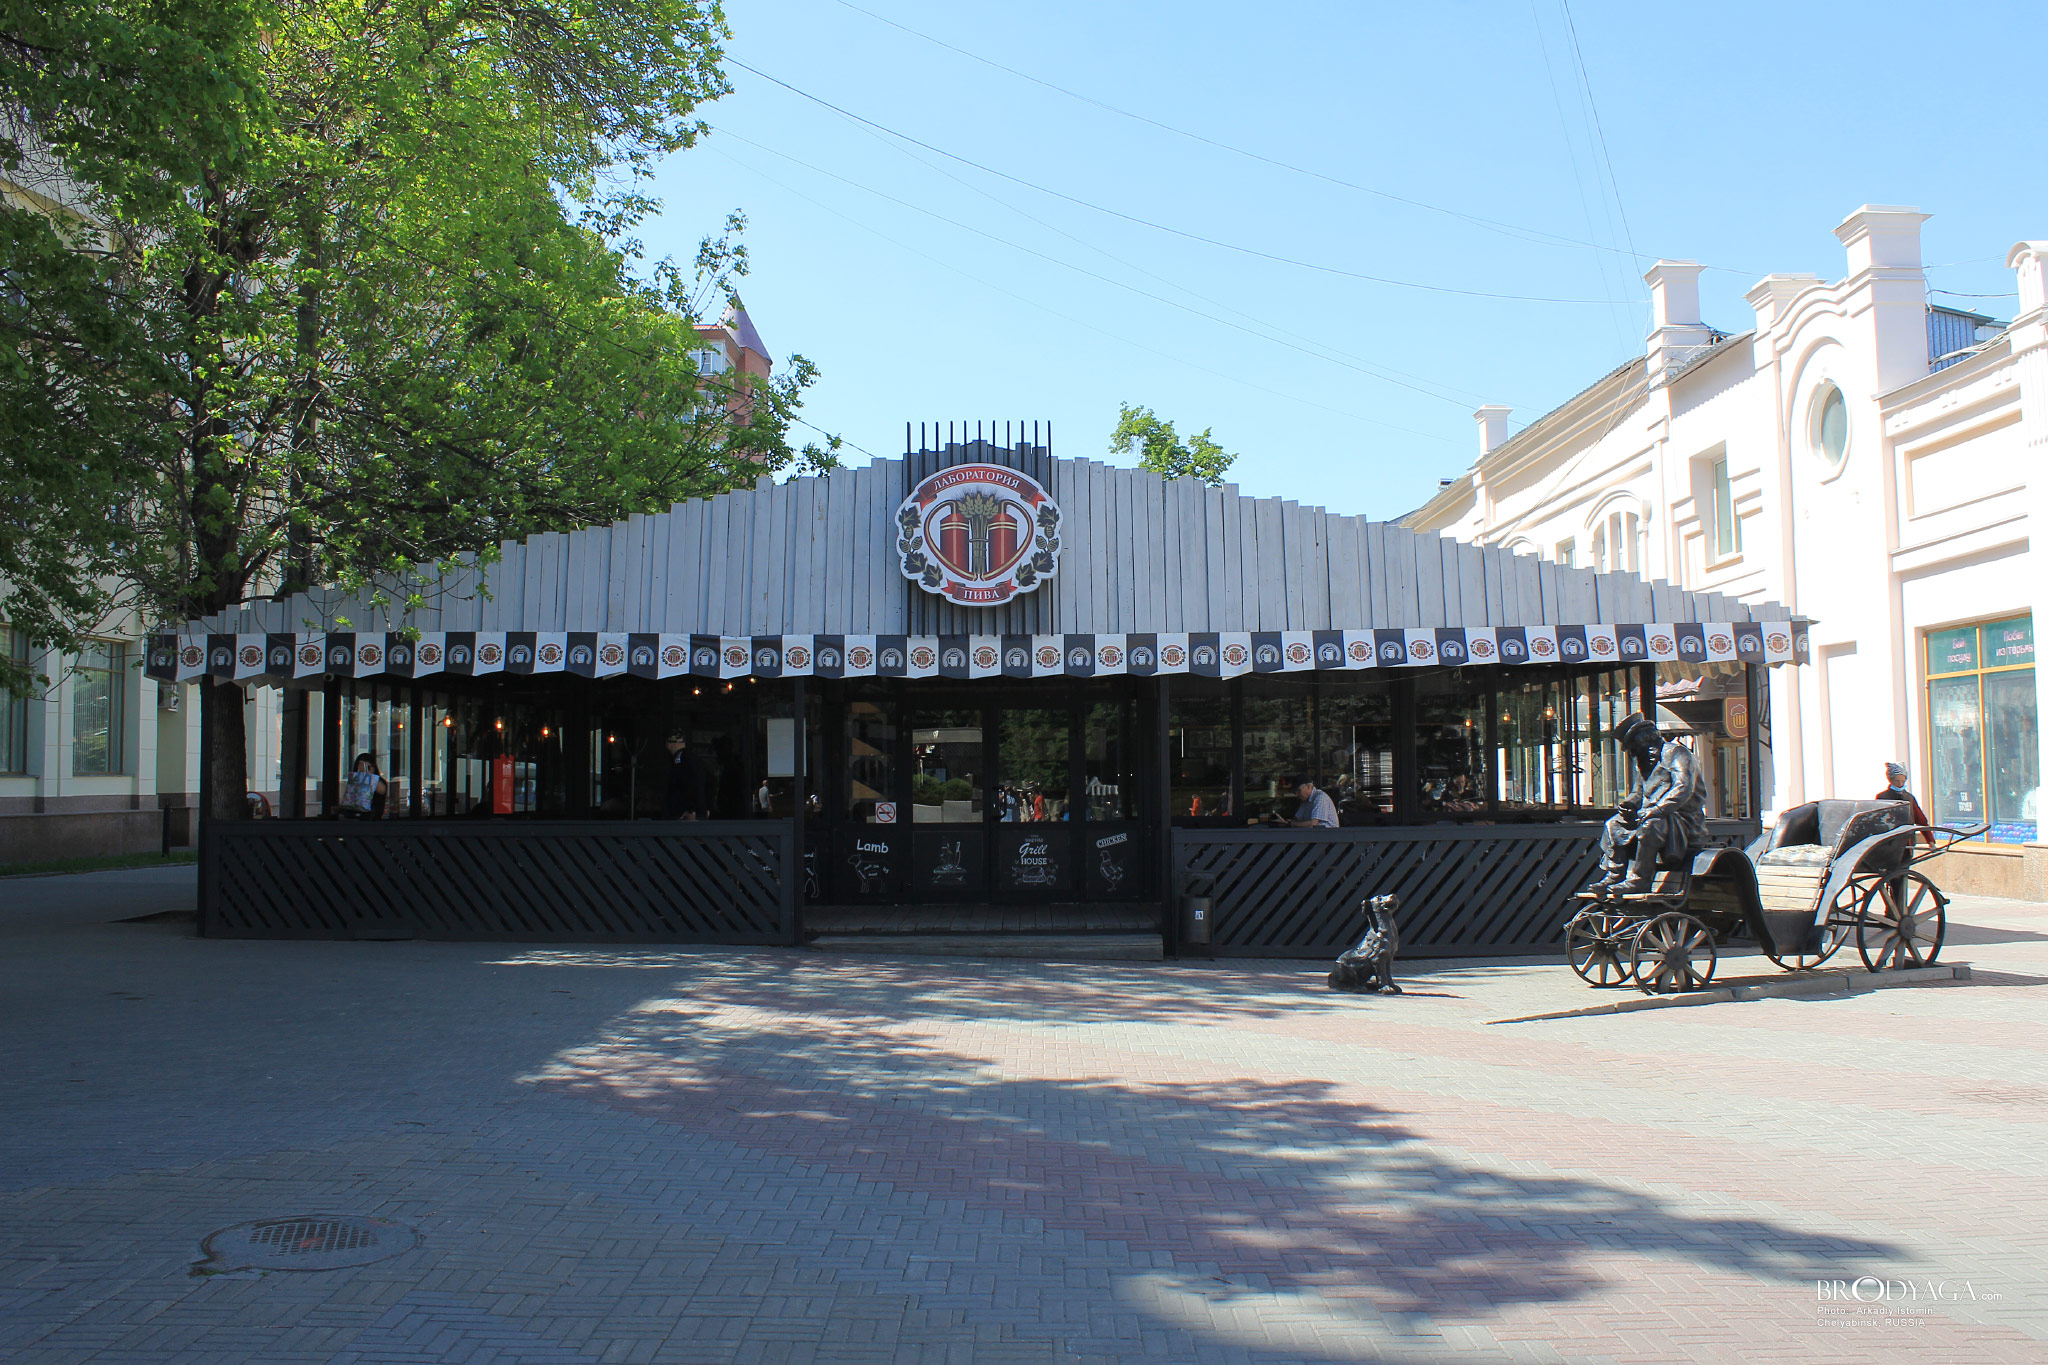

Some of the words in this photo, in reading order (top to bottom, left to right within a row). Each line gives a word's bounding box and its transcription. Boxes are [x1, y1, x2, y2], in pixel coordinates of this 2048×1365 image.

[934, 471, 1020, 491] ЛАБОРАТОРИЯ
[963, 589, 1000, 600] ПИВА
[856, 838, 889, 854] Lamb
[1096, 833, 1127, 848] CHICKEN
[1019, 842, 1048, 858] Grill
